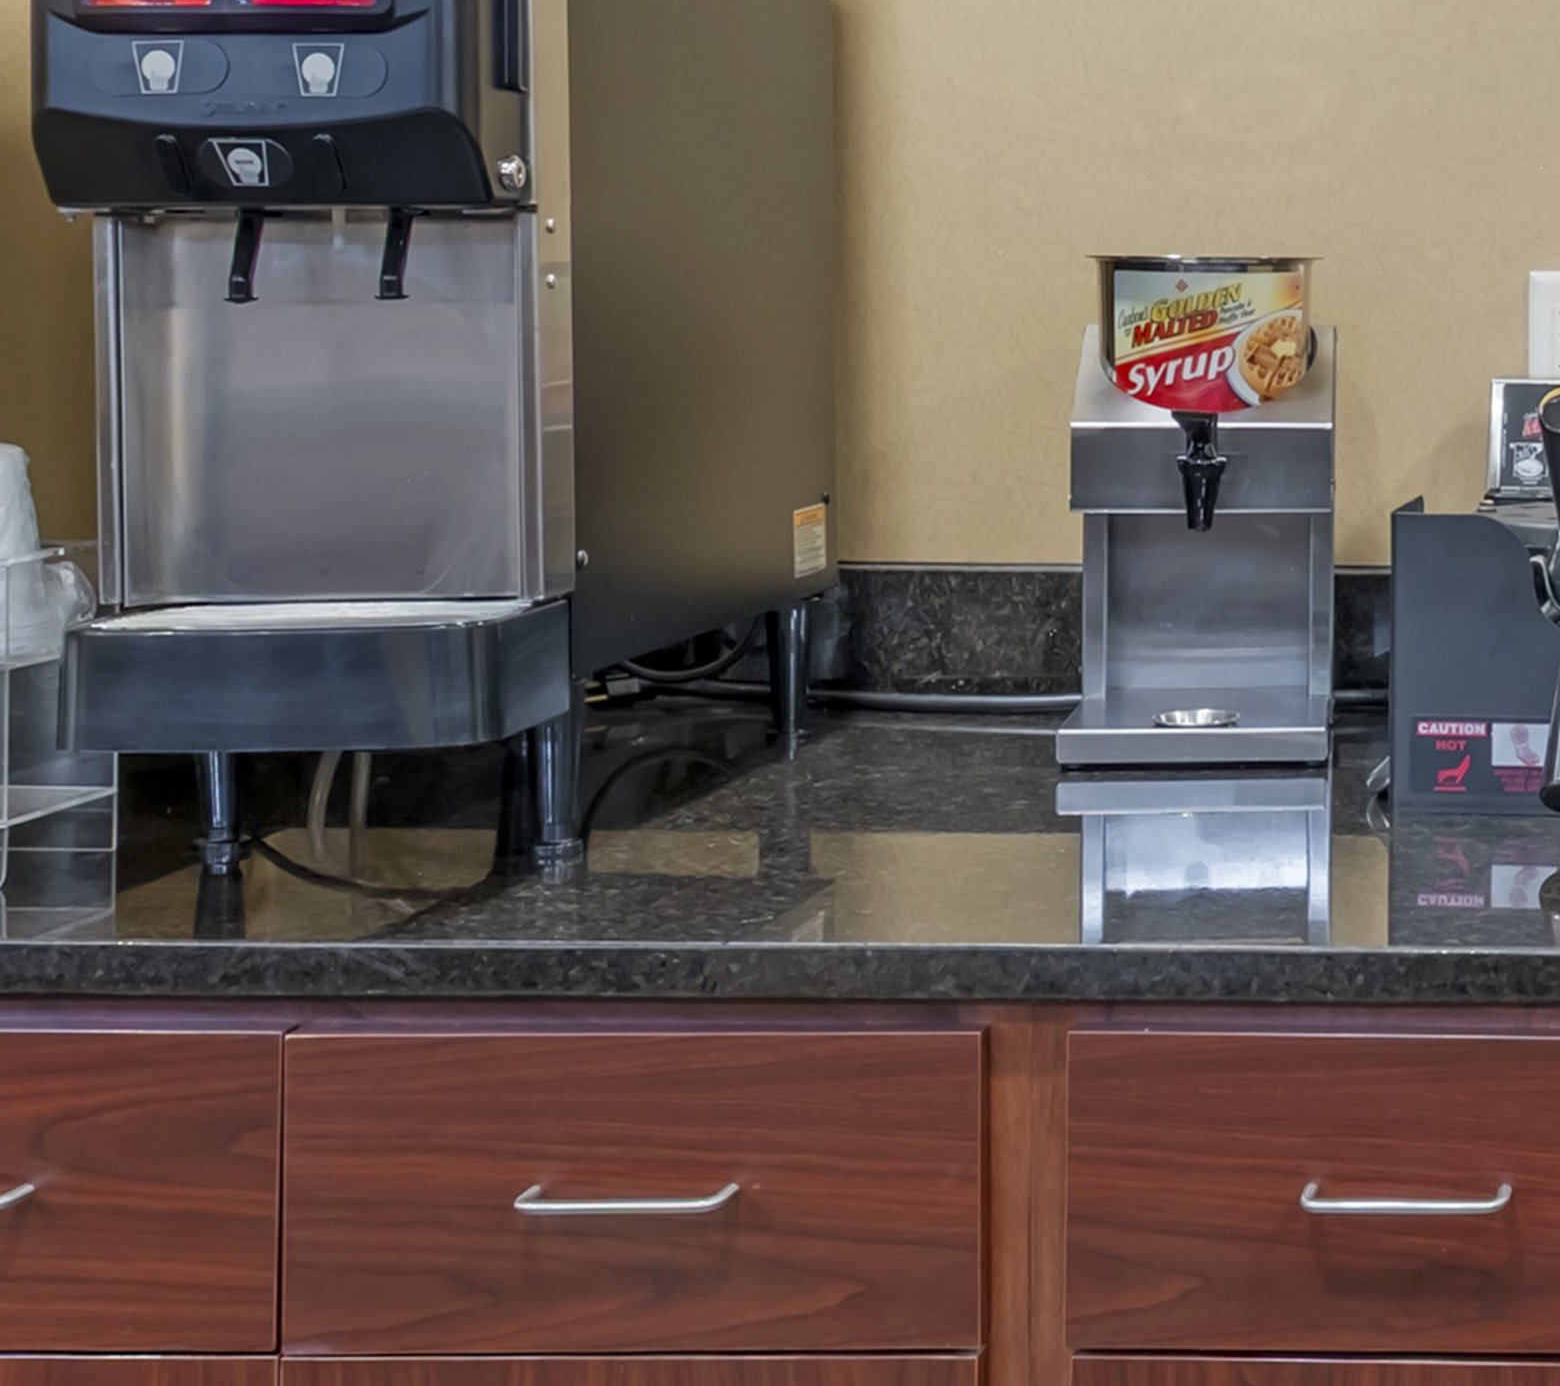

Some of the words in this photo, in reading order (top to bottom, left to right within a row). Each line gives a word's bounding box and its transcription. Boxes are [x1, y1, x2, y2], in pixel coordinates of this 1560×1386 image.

[1151, 283, 1242, 323] GOLDEN
[1132, 309, 1219, 348] MALTED
[1127, 345, 1235, 396] Syrup
[1418, 723, 1486, 734] CAUTION
[1436, 740, 1466, 750] HOT
